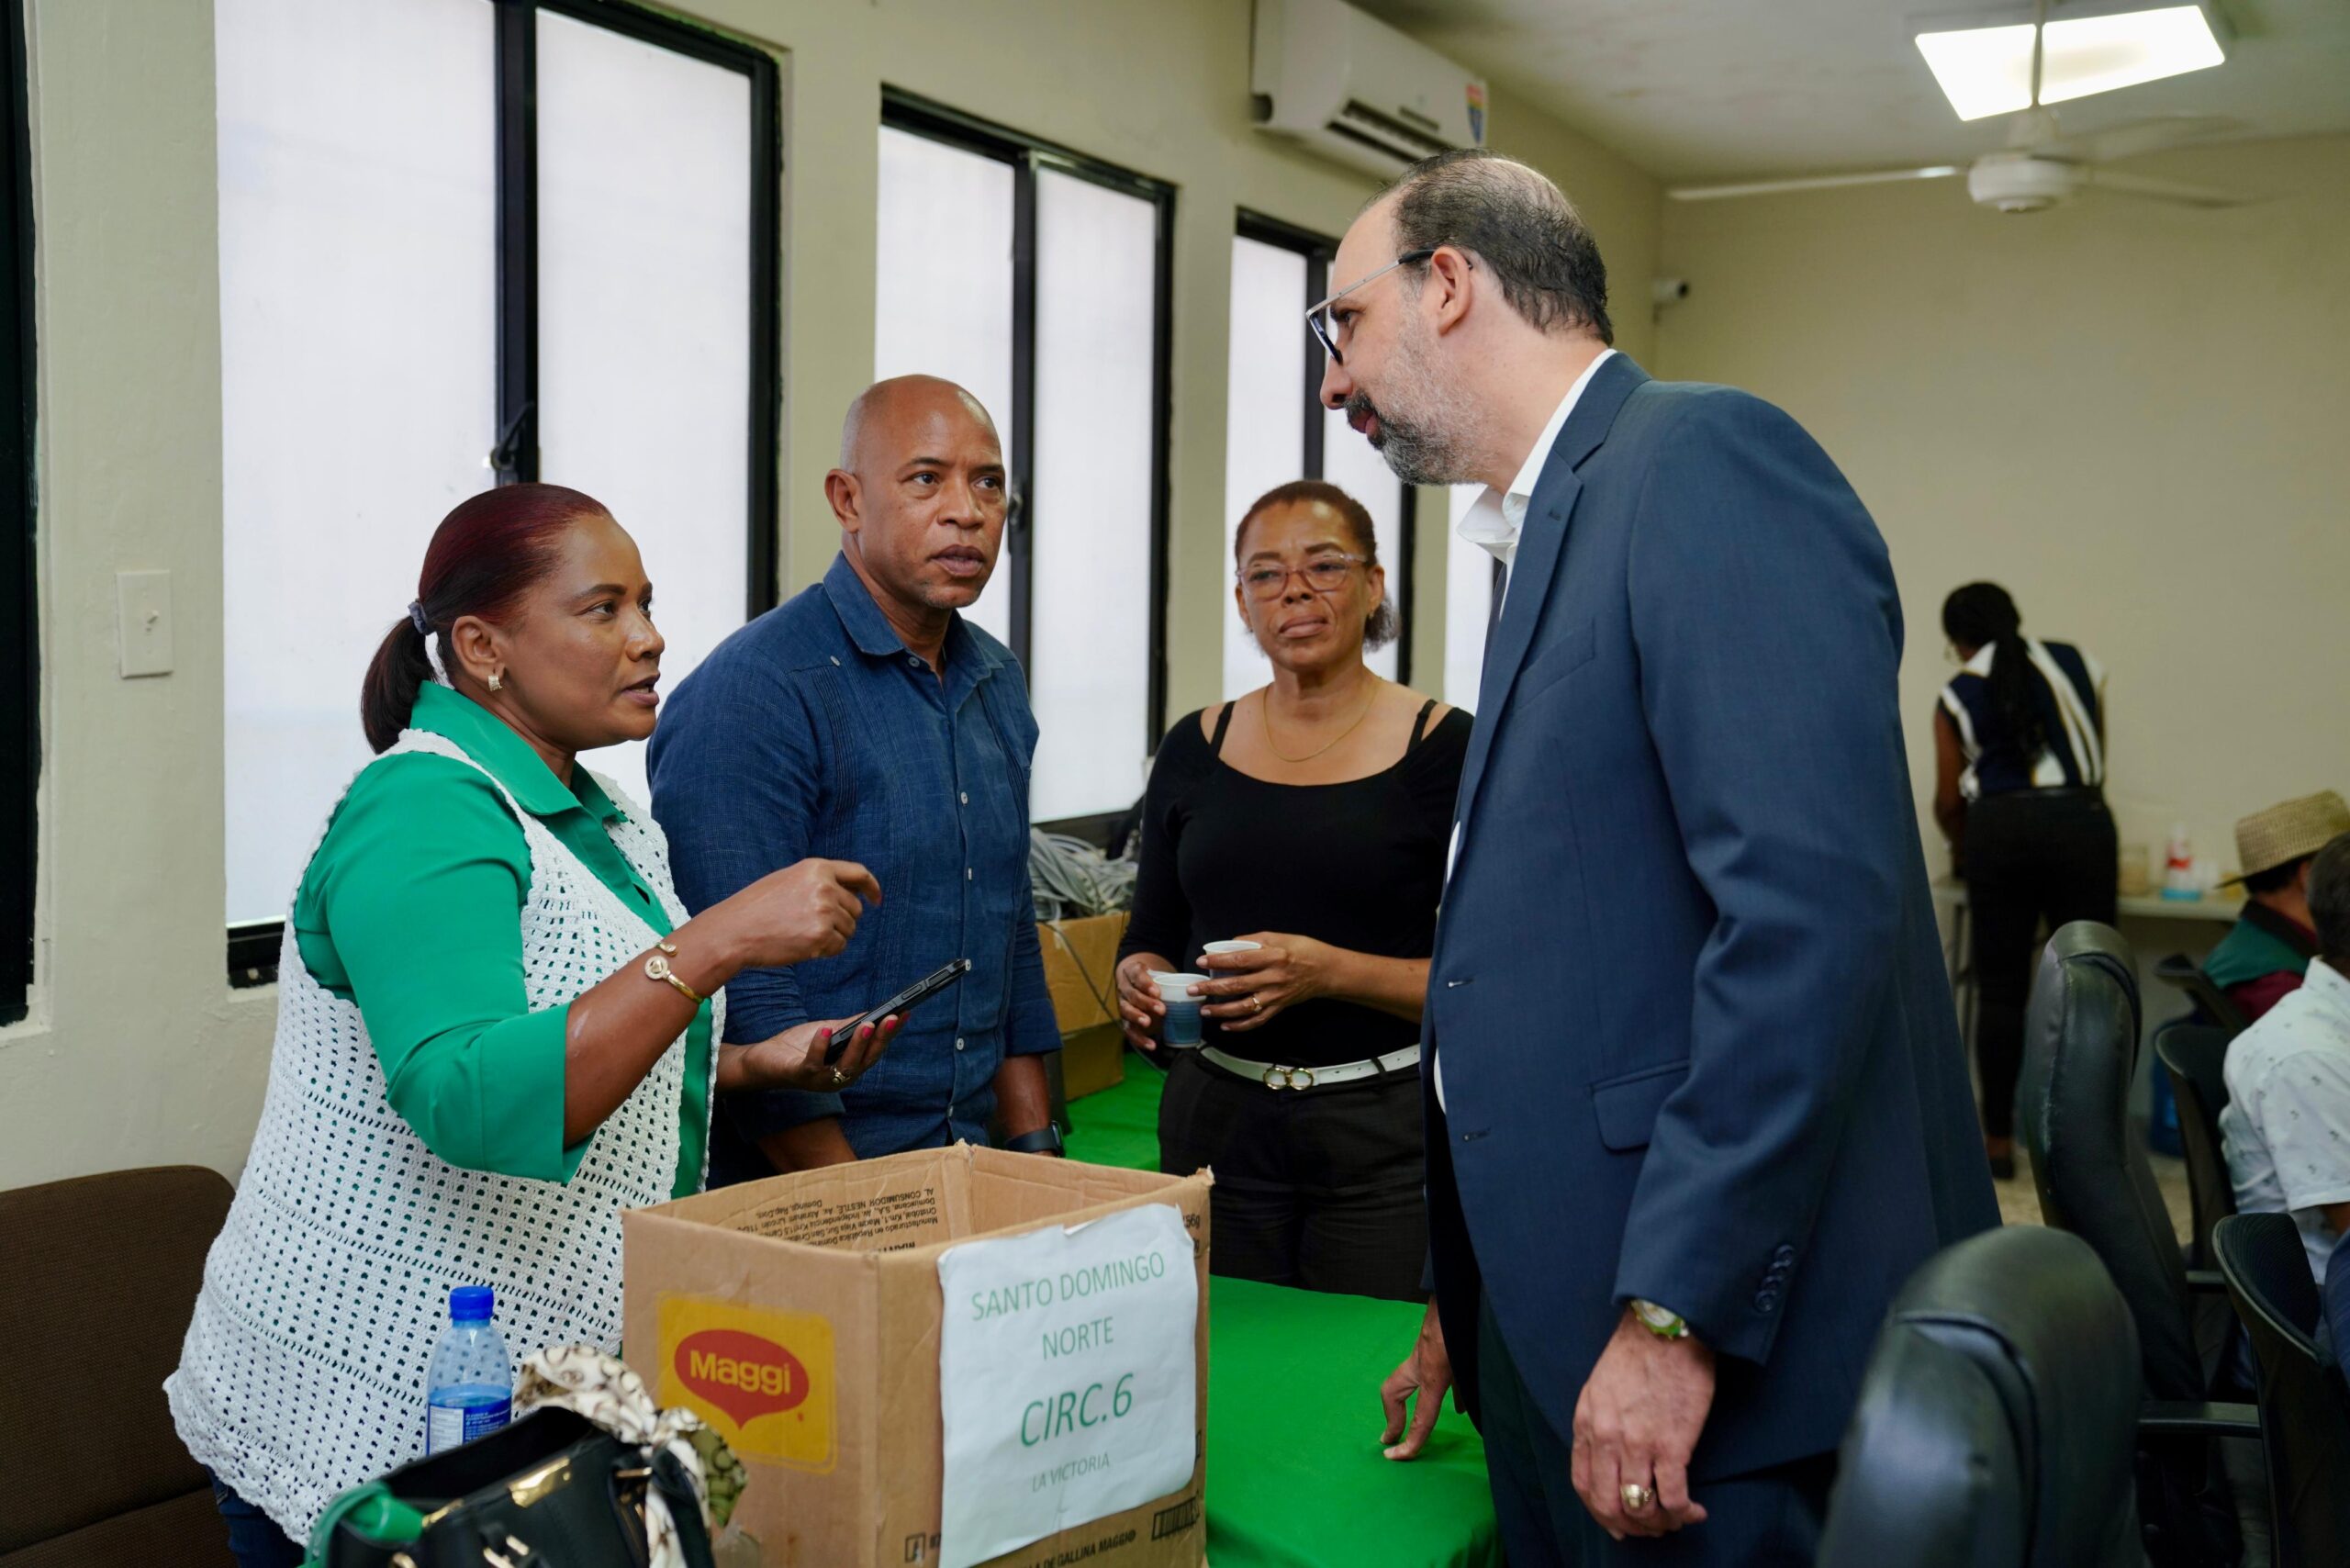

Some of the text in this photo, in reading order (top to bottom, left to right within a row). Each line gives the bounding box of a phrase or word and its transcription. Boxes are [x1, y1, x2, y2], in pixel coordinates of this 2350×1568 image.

[869, 1191, 921, 1206] CONSUMIDOR
[885, 1216, 938, 1232] Manufacturado
[1182, 1213, 1201, 1230] 56g
[971, 1251, 1165, 1322] SANTO DOMINGO
[1042, 1316, 1114, 1361] NORTE
[689, 1350, 791, 1396] Maggi
[1021, 1372, 1134, 1447] CIRC.6
[1032, 1451, 1110, 1493] LA VICTORIA
[1057, 1541, 1097, 1567] GALLINA
